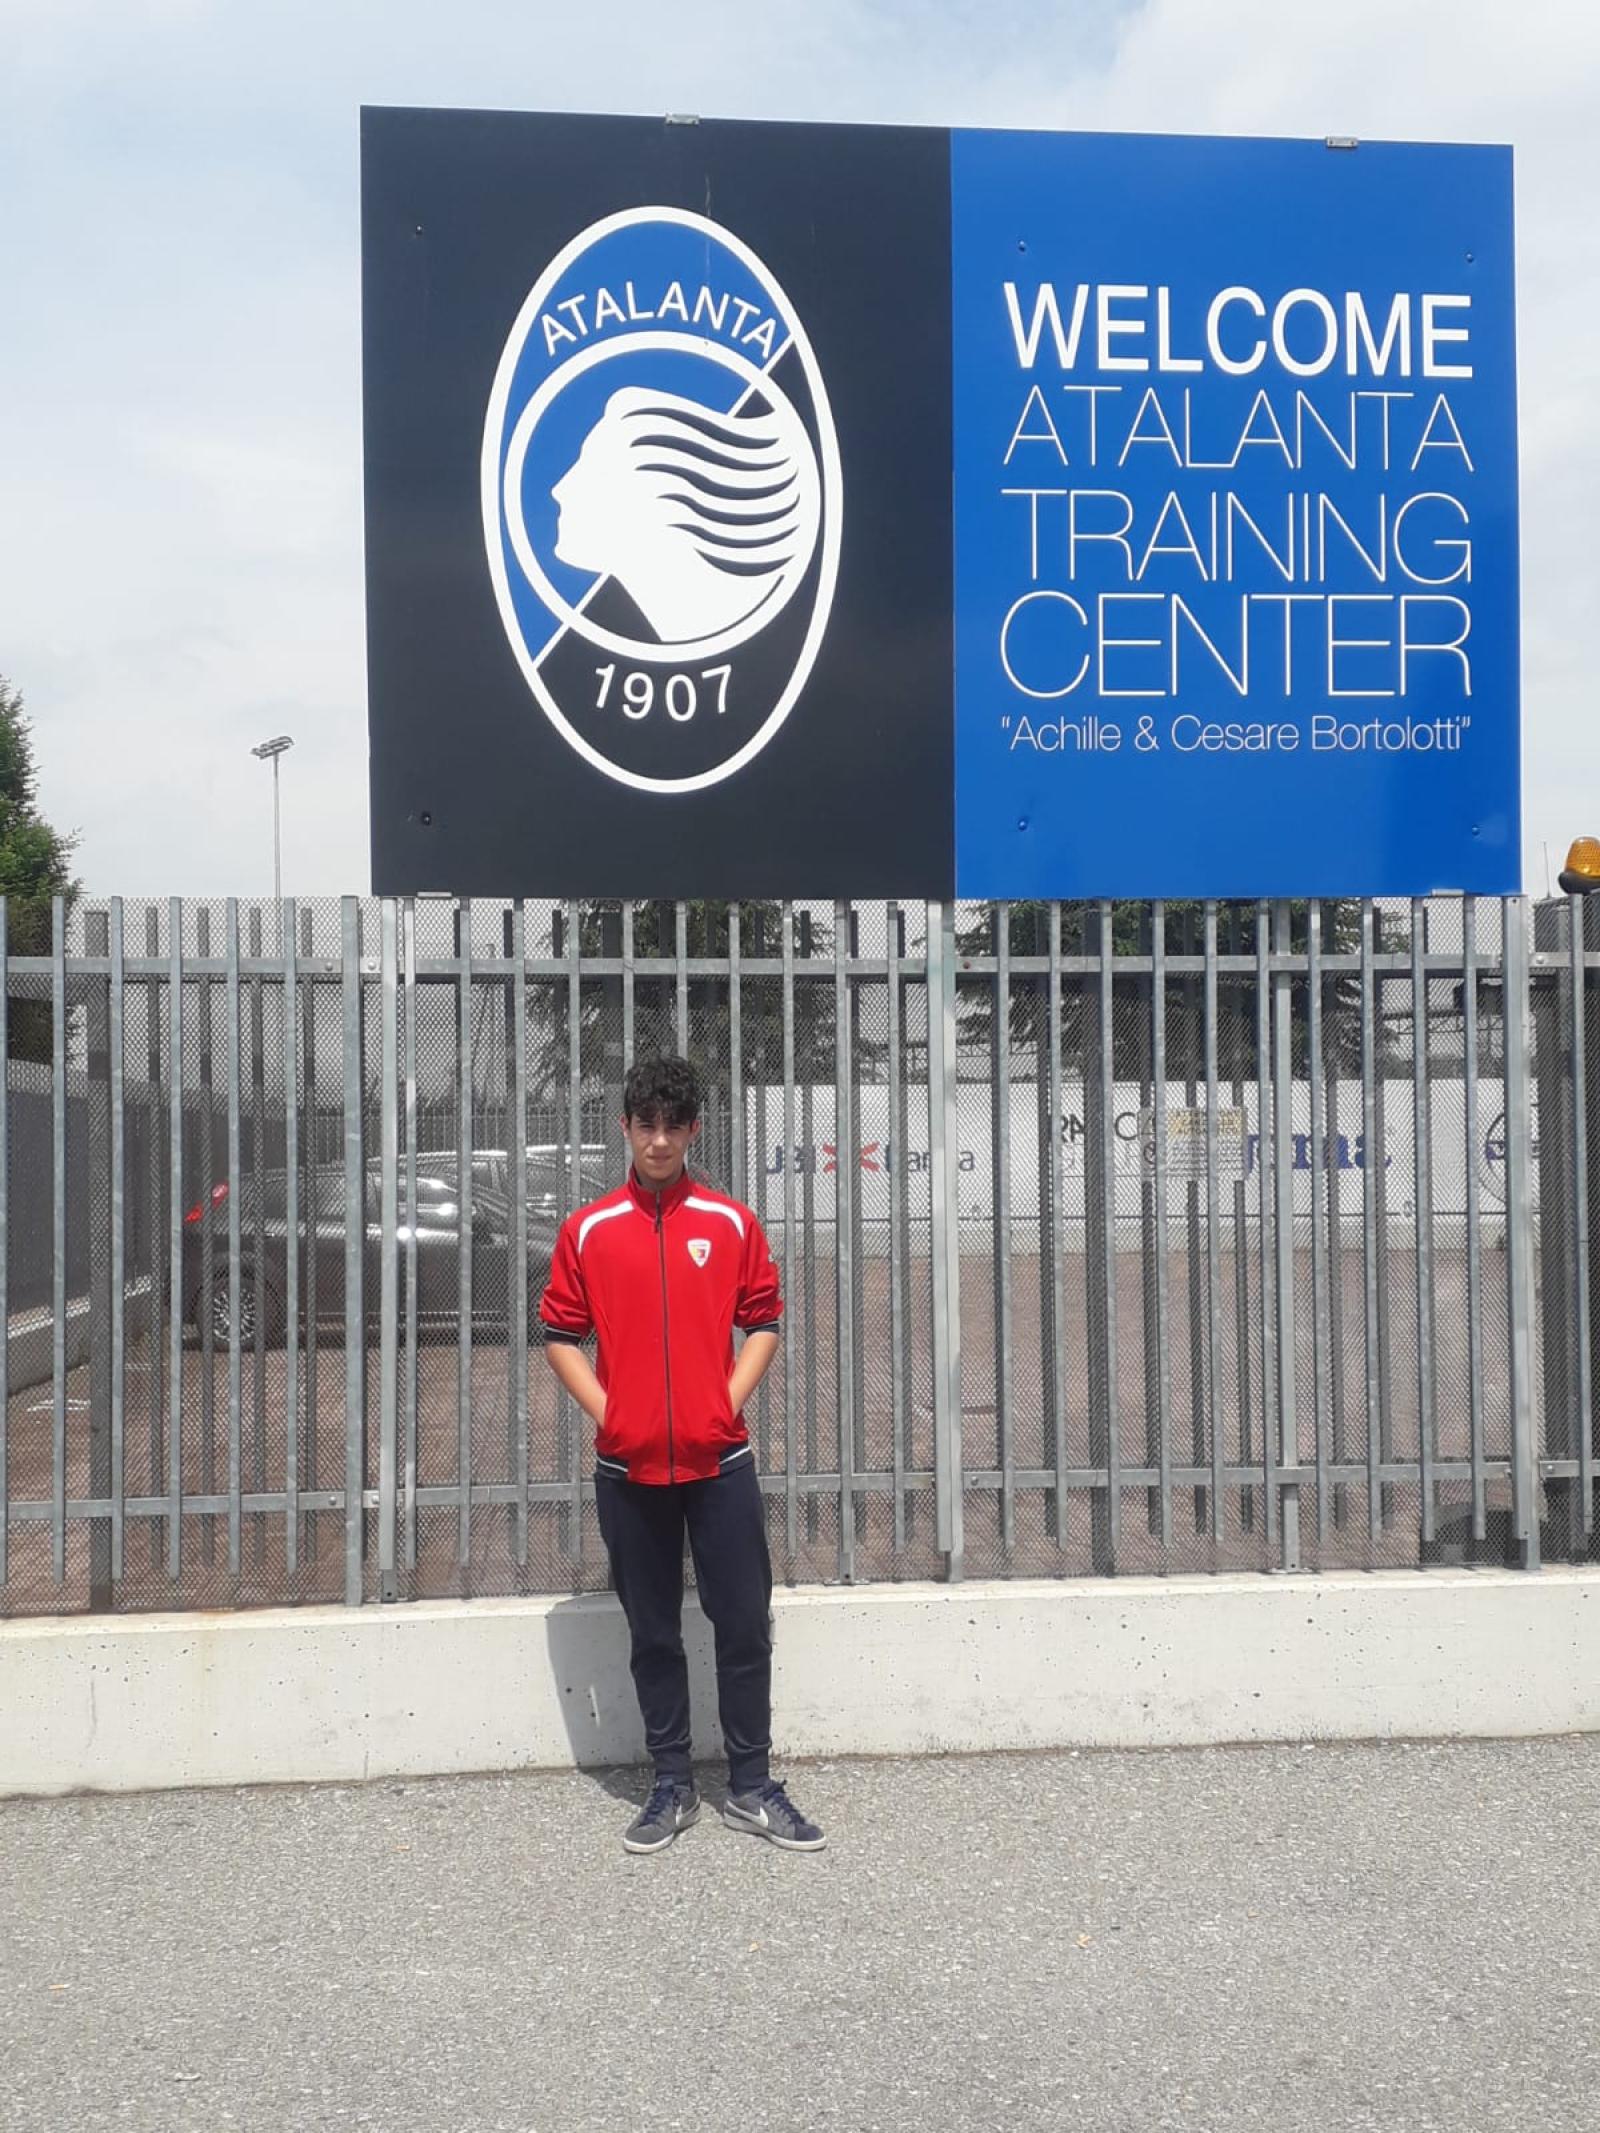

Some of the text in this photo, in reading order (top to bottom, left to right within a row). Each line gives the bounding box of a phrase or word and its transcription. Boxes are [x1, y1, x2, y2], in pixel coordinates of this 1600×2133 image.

[540, 280, 778, 359] ATALANTA
[1003, 282, 1473, 378] WELCOME
[1003, 385, 1474, 472] ATALANTA
[1001, 489, 1472, 585] TRAINING
[1000, 590, 1472, 698] CENTER
[594, 662, 733, 723] 1907
[1134, 715, 1160, 752] &
[1170, 714, 1300, 752] Cesare
